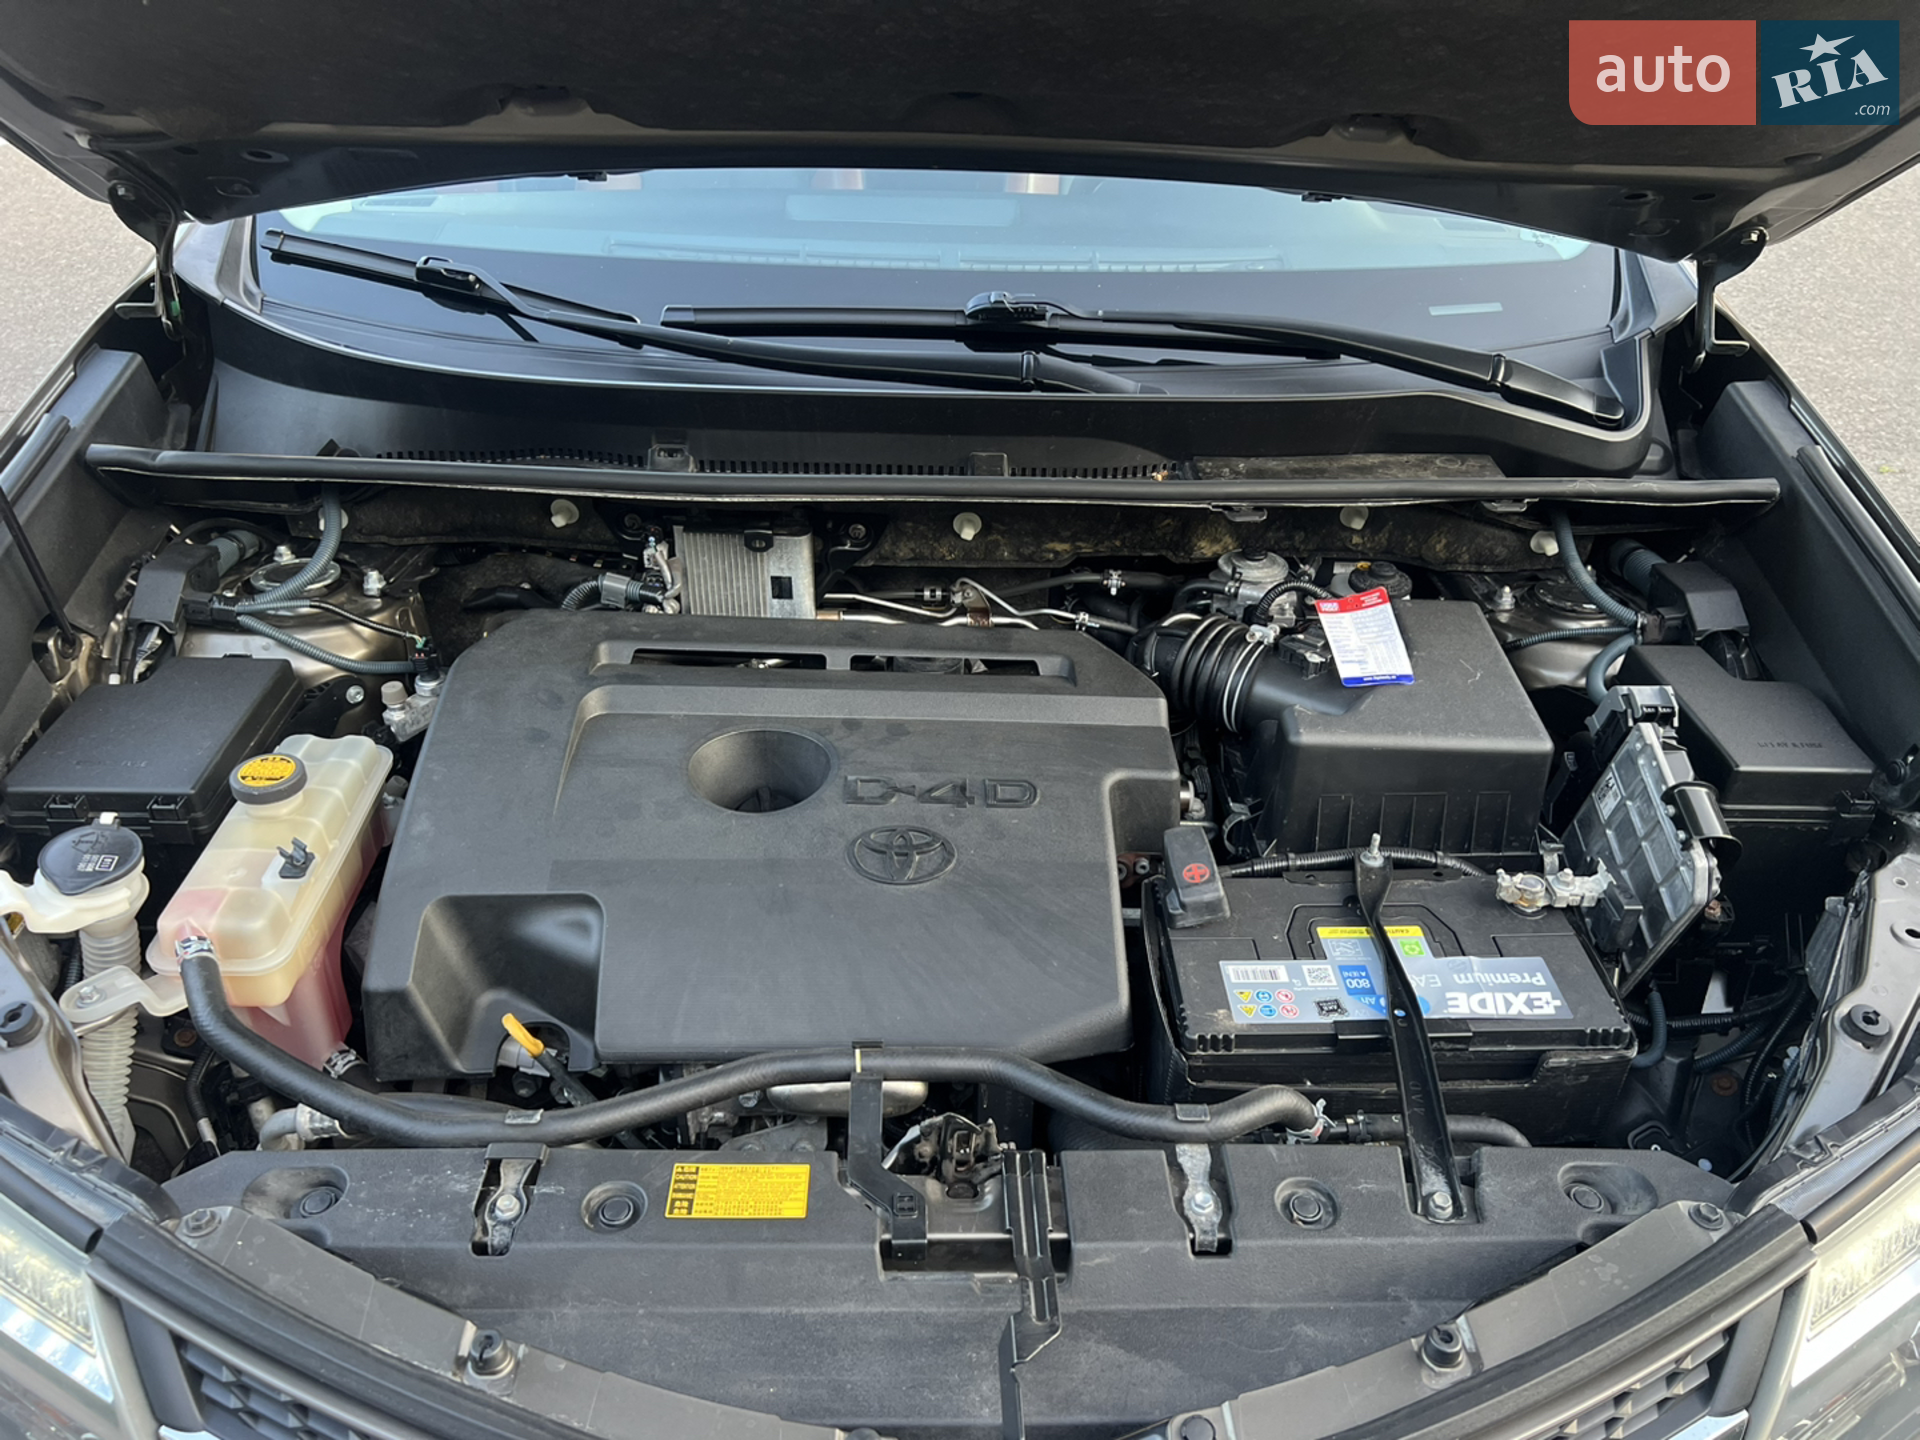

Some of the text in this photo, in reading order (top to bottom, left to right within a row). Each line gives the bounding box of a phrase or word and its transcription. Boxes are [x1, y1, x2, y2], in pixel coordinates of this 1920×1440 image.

[843, 775, 1041, 808] D-4D
[1346, 979, 1371, 988] 800
[1453, 972, 1547, 987] Premium
[1445, 992, 1561, 1015] EXIDE
